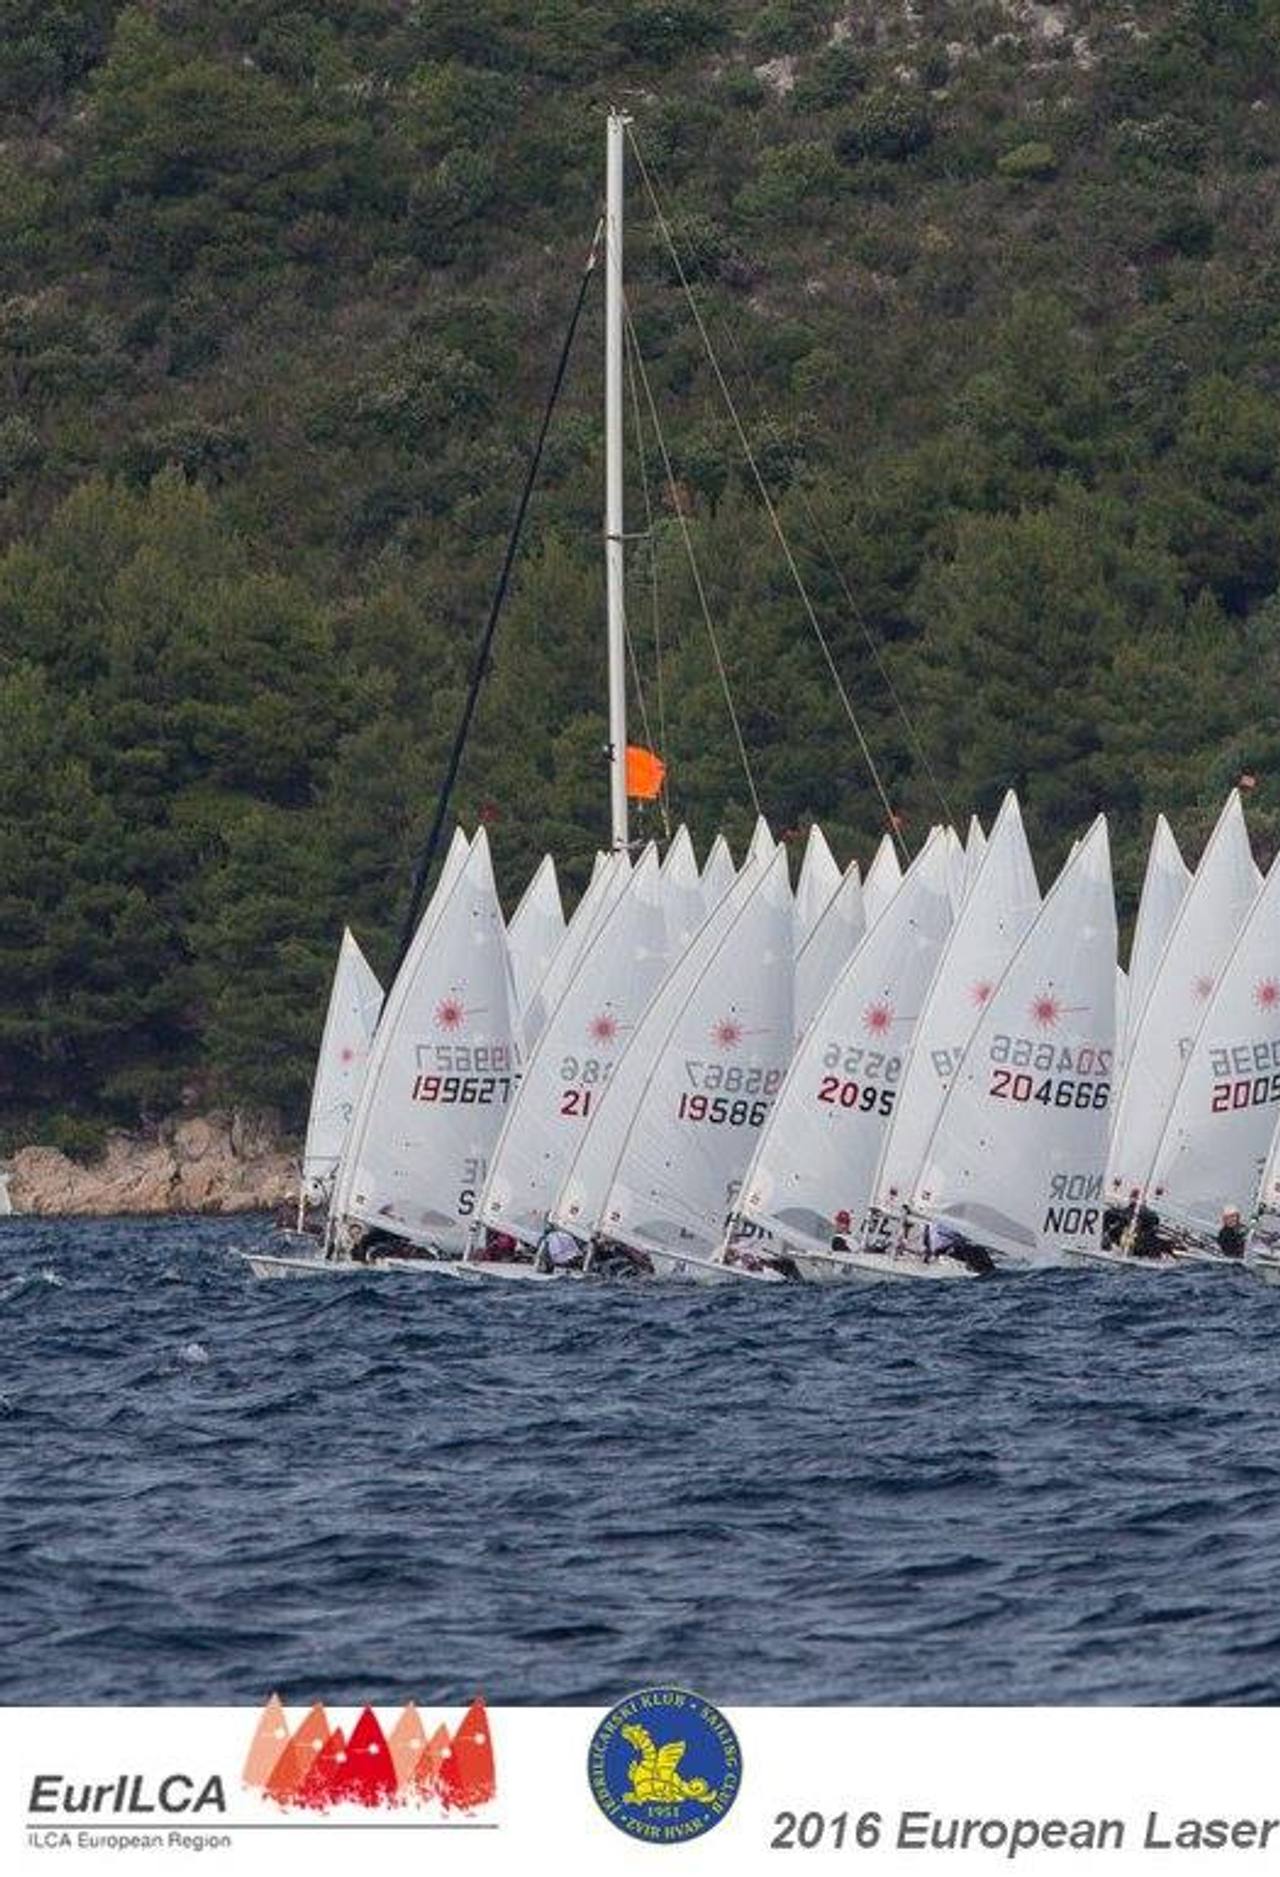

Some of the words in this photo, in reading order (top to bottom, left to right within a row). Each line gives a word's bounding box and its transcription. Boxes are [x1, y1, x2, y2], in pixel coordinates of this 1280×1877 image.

[411, 1075, 511, 1104] 199627
[988, 1069, 1112, 1110] 204666
[1043, 1206, 1099, 1236] NOR
